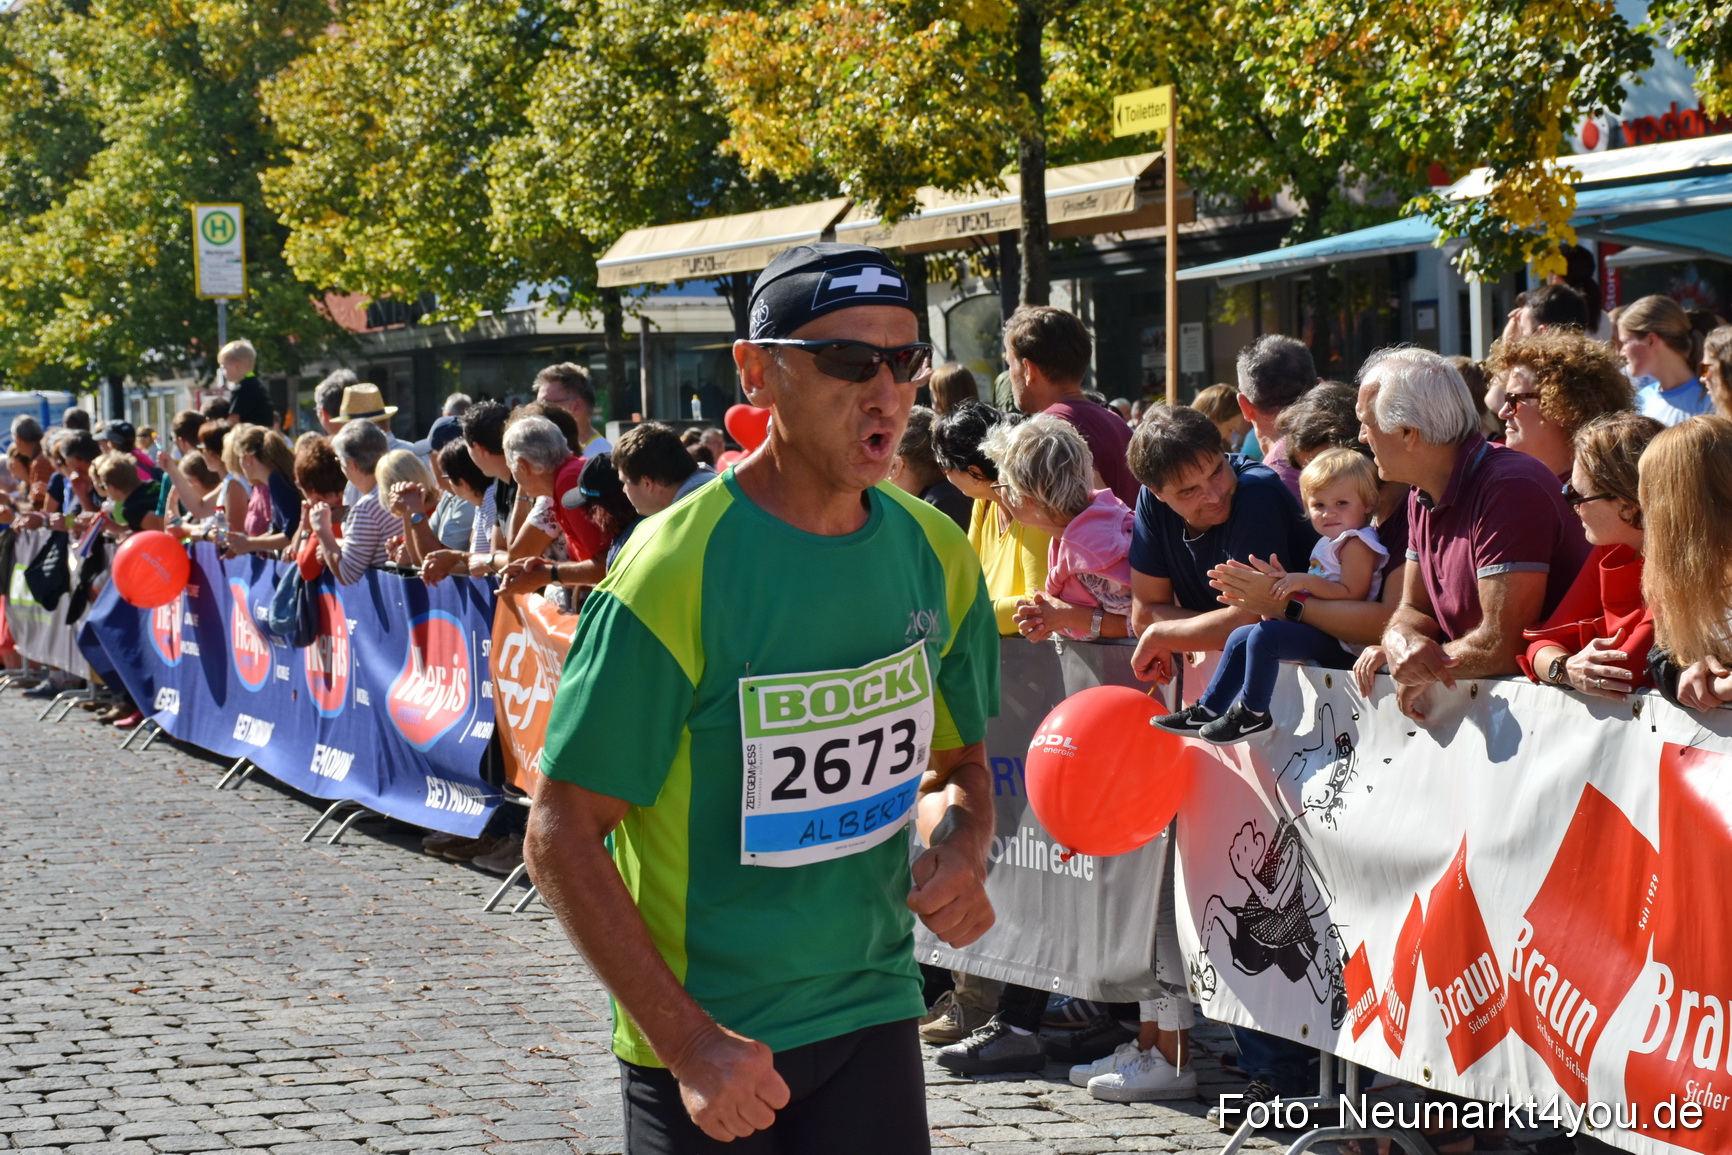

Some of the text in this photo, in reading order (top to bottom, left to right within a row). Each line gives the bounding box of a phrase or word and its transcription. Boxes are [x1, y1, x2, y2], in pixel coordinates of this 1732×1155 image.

[1124, 102, 1168, 123] Toiletten
[1622, 99, 1732, 147] vodafo
[394, 644, 467, 721] Hervis
[763, 658, 921, 724] BOCK
[771, 718, 917, 801] 2673
[1043, 746, 1075, 758] energie
[425, 775, 447, 810] GET
[799, 788, 911, 845] ALBERT
[1637, 873, 1660, 930] Seit 1929
[1347, 987, 1375, 1025] Braun
[1428, 952, 1501, 1037] Braun
[1509, 916, 1599, 1056] Braun
[1468, 1013, 1491, 1035] Sicher
[1488, 1004, 1498, 1019] ist
[1535, 1014, 1554, 1049] Sicher
[1555, 1041, 1565, 1062] ist
[1630, 960, 1732, 1077] Bra
[1683, 1079, 1731, 1112] Sicher
